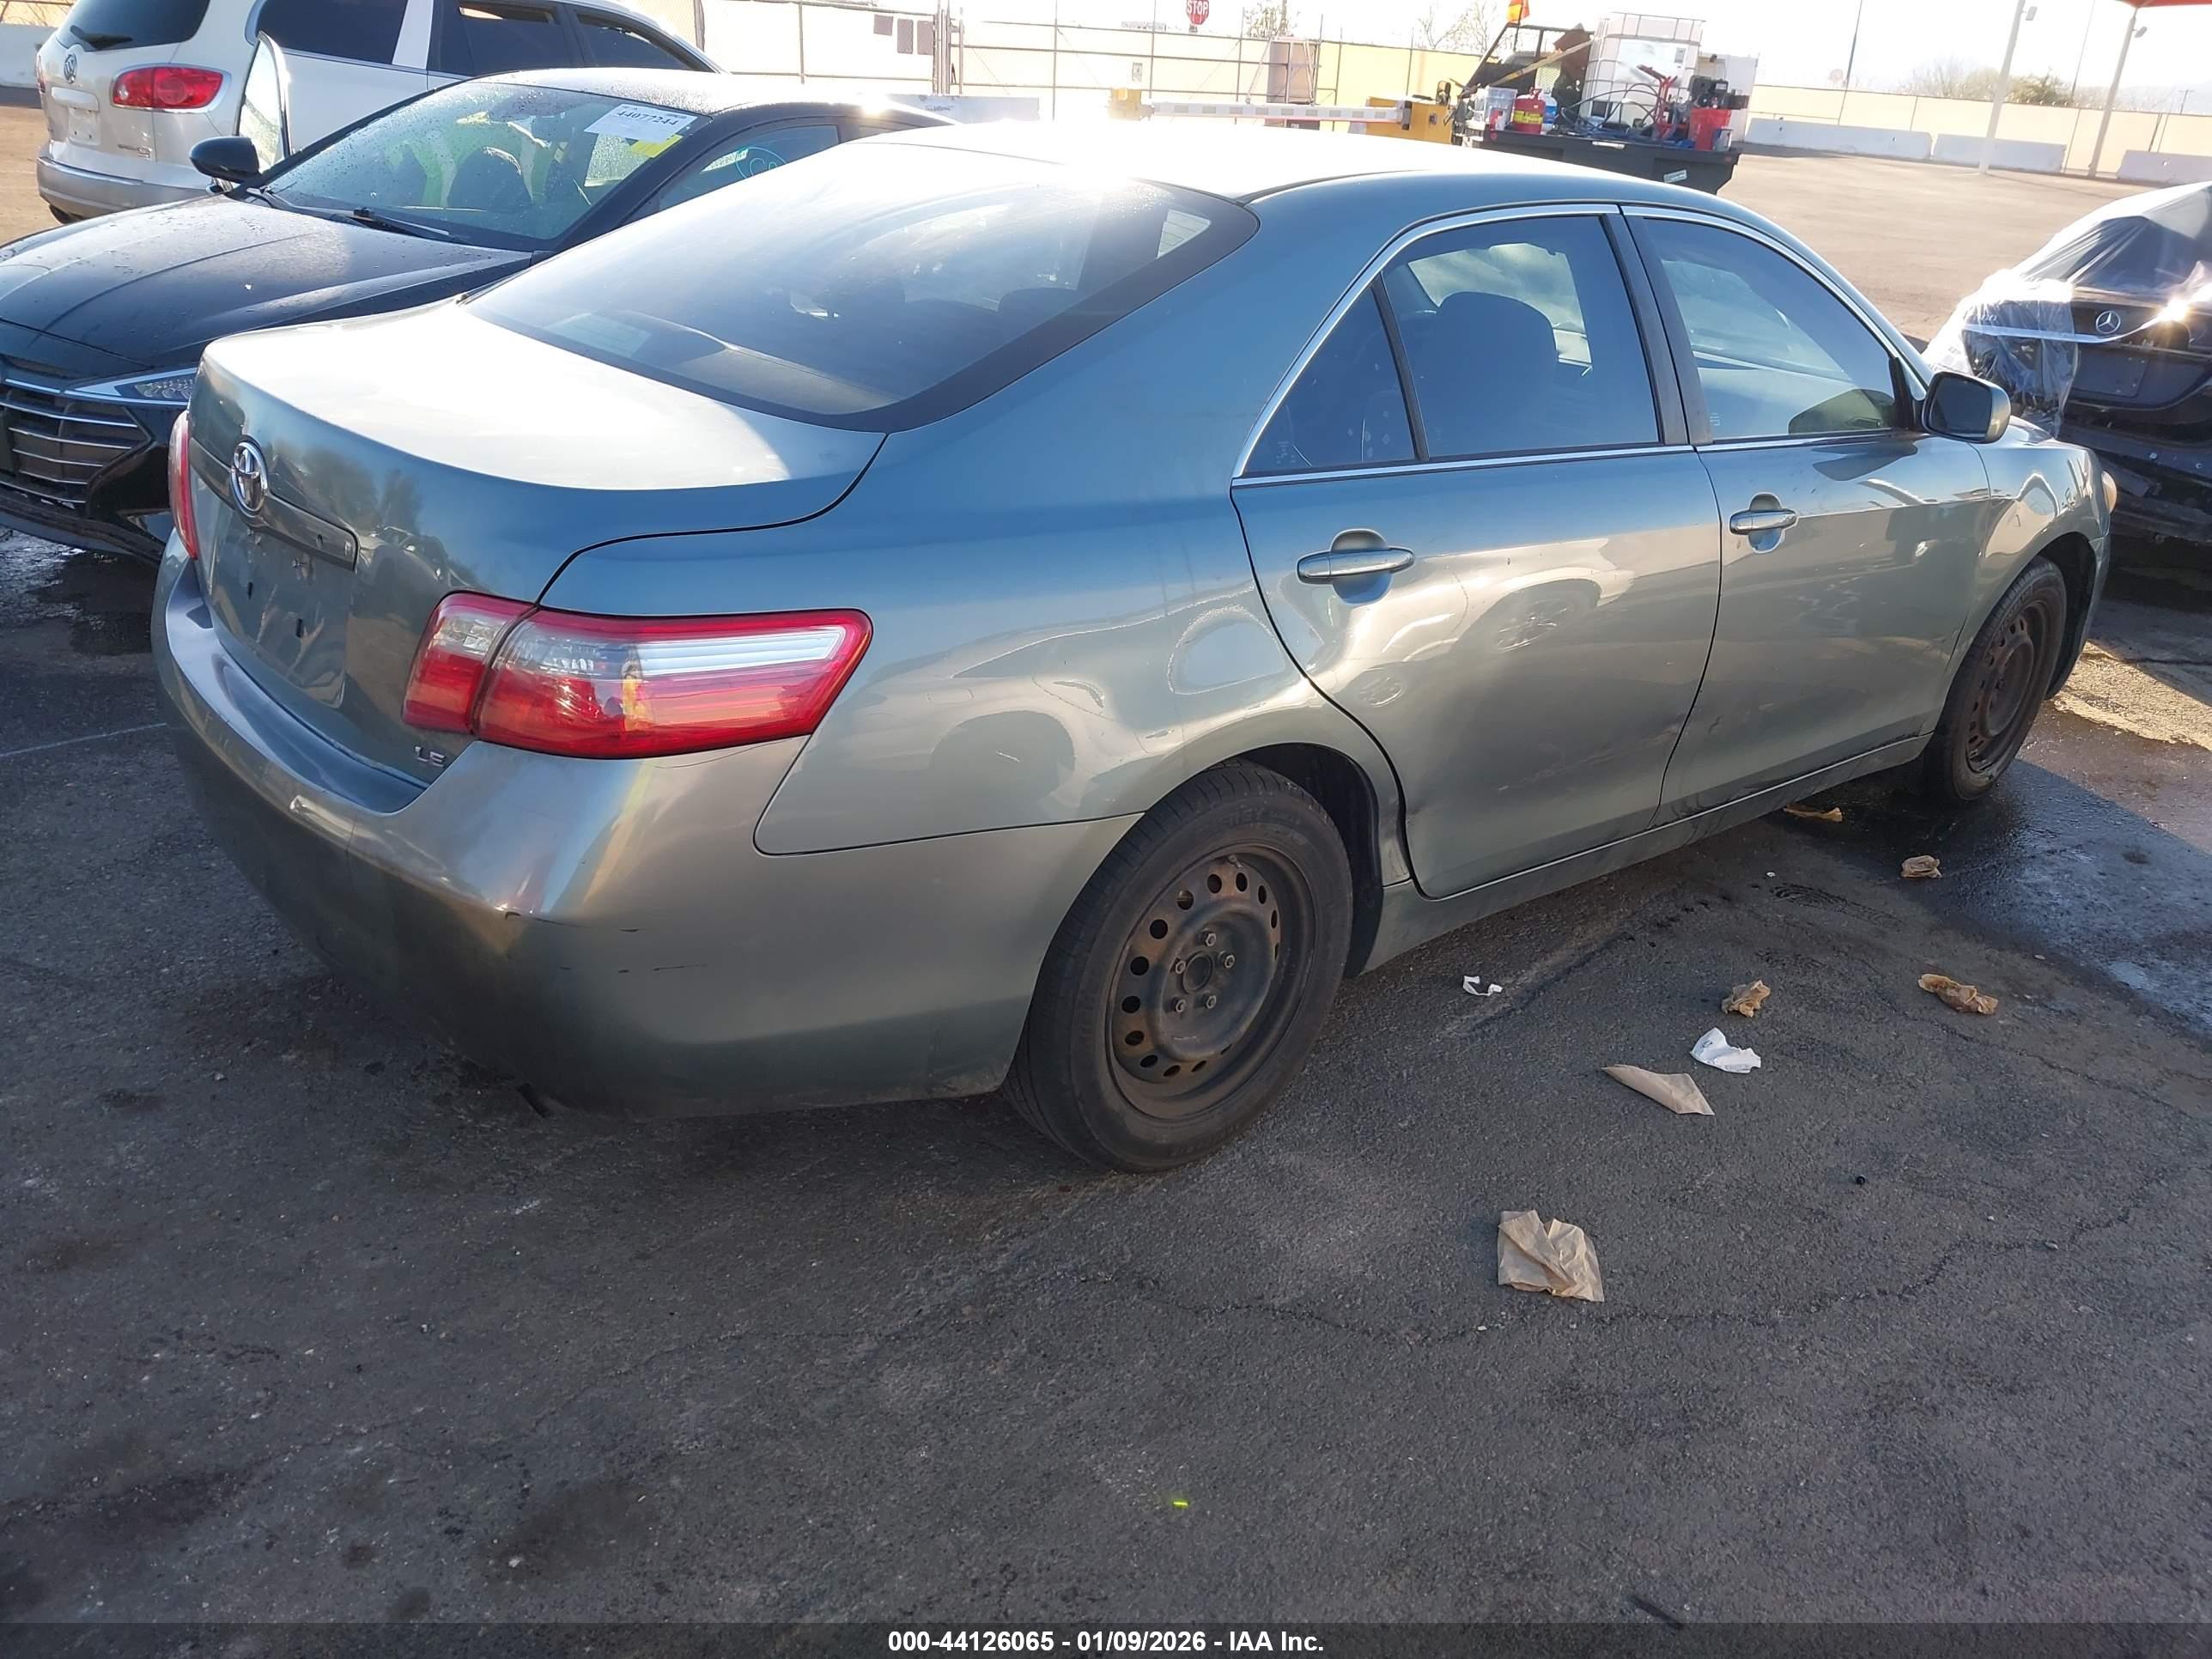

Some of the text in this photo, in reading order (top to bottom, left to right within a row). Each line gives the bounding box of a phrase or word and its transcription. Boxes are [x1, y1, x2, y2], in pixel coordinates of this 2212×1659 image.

[1187, 0, 1208, 15] STOP
[617, 110, 679, 126] 44077244
[414, 745, 446, 768] LE
